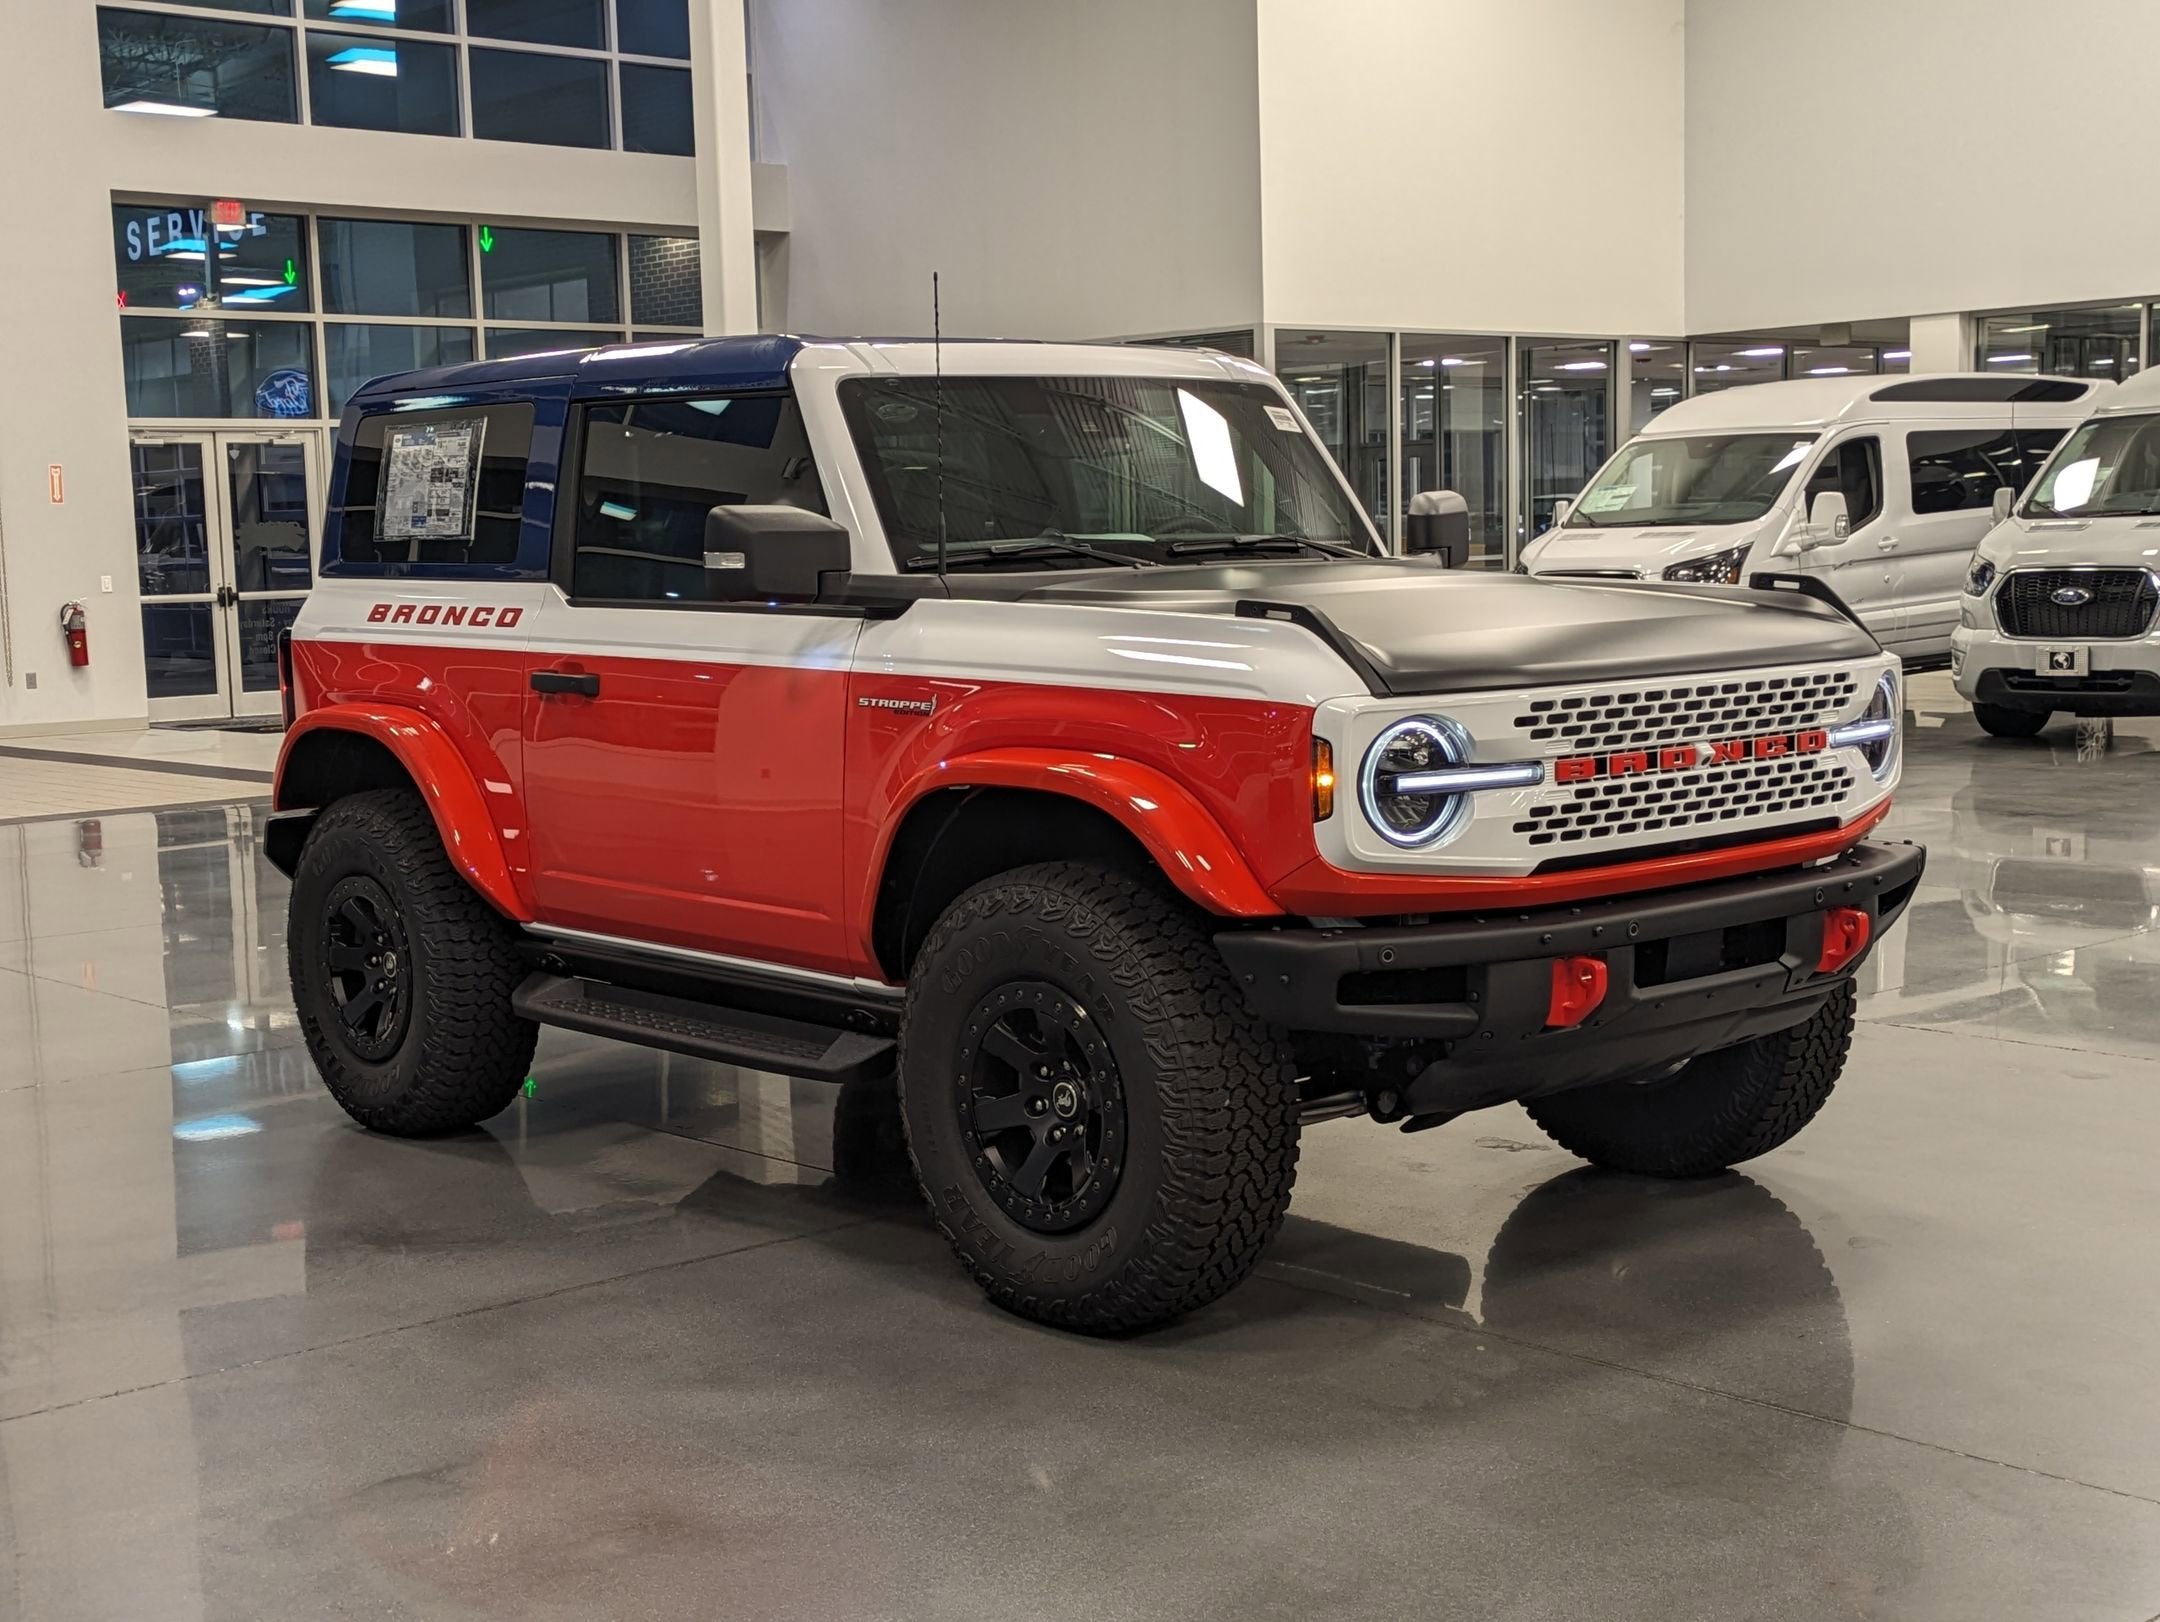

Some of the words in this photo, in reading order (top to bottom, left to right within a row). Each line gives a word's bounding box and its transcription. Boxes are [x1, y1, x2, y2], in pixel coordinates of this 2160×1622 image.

[367, 604, 524, 628] BRONCO
[858, 697, 932, 711] STROPPE
[1554, 730, 1827, 783] BRONCO
[942, 925, 1116, 1024] GOODYEAR
[943, 1182, 1118, 1286] GOODYEAR
